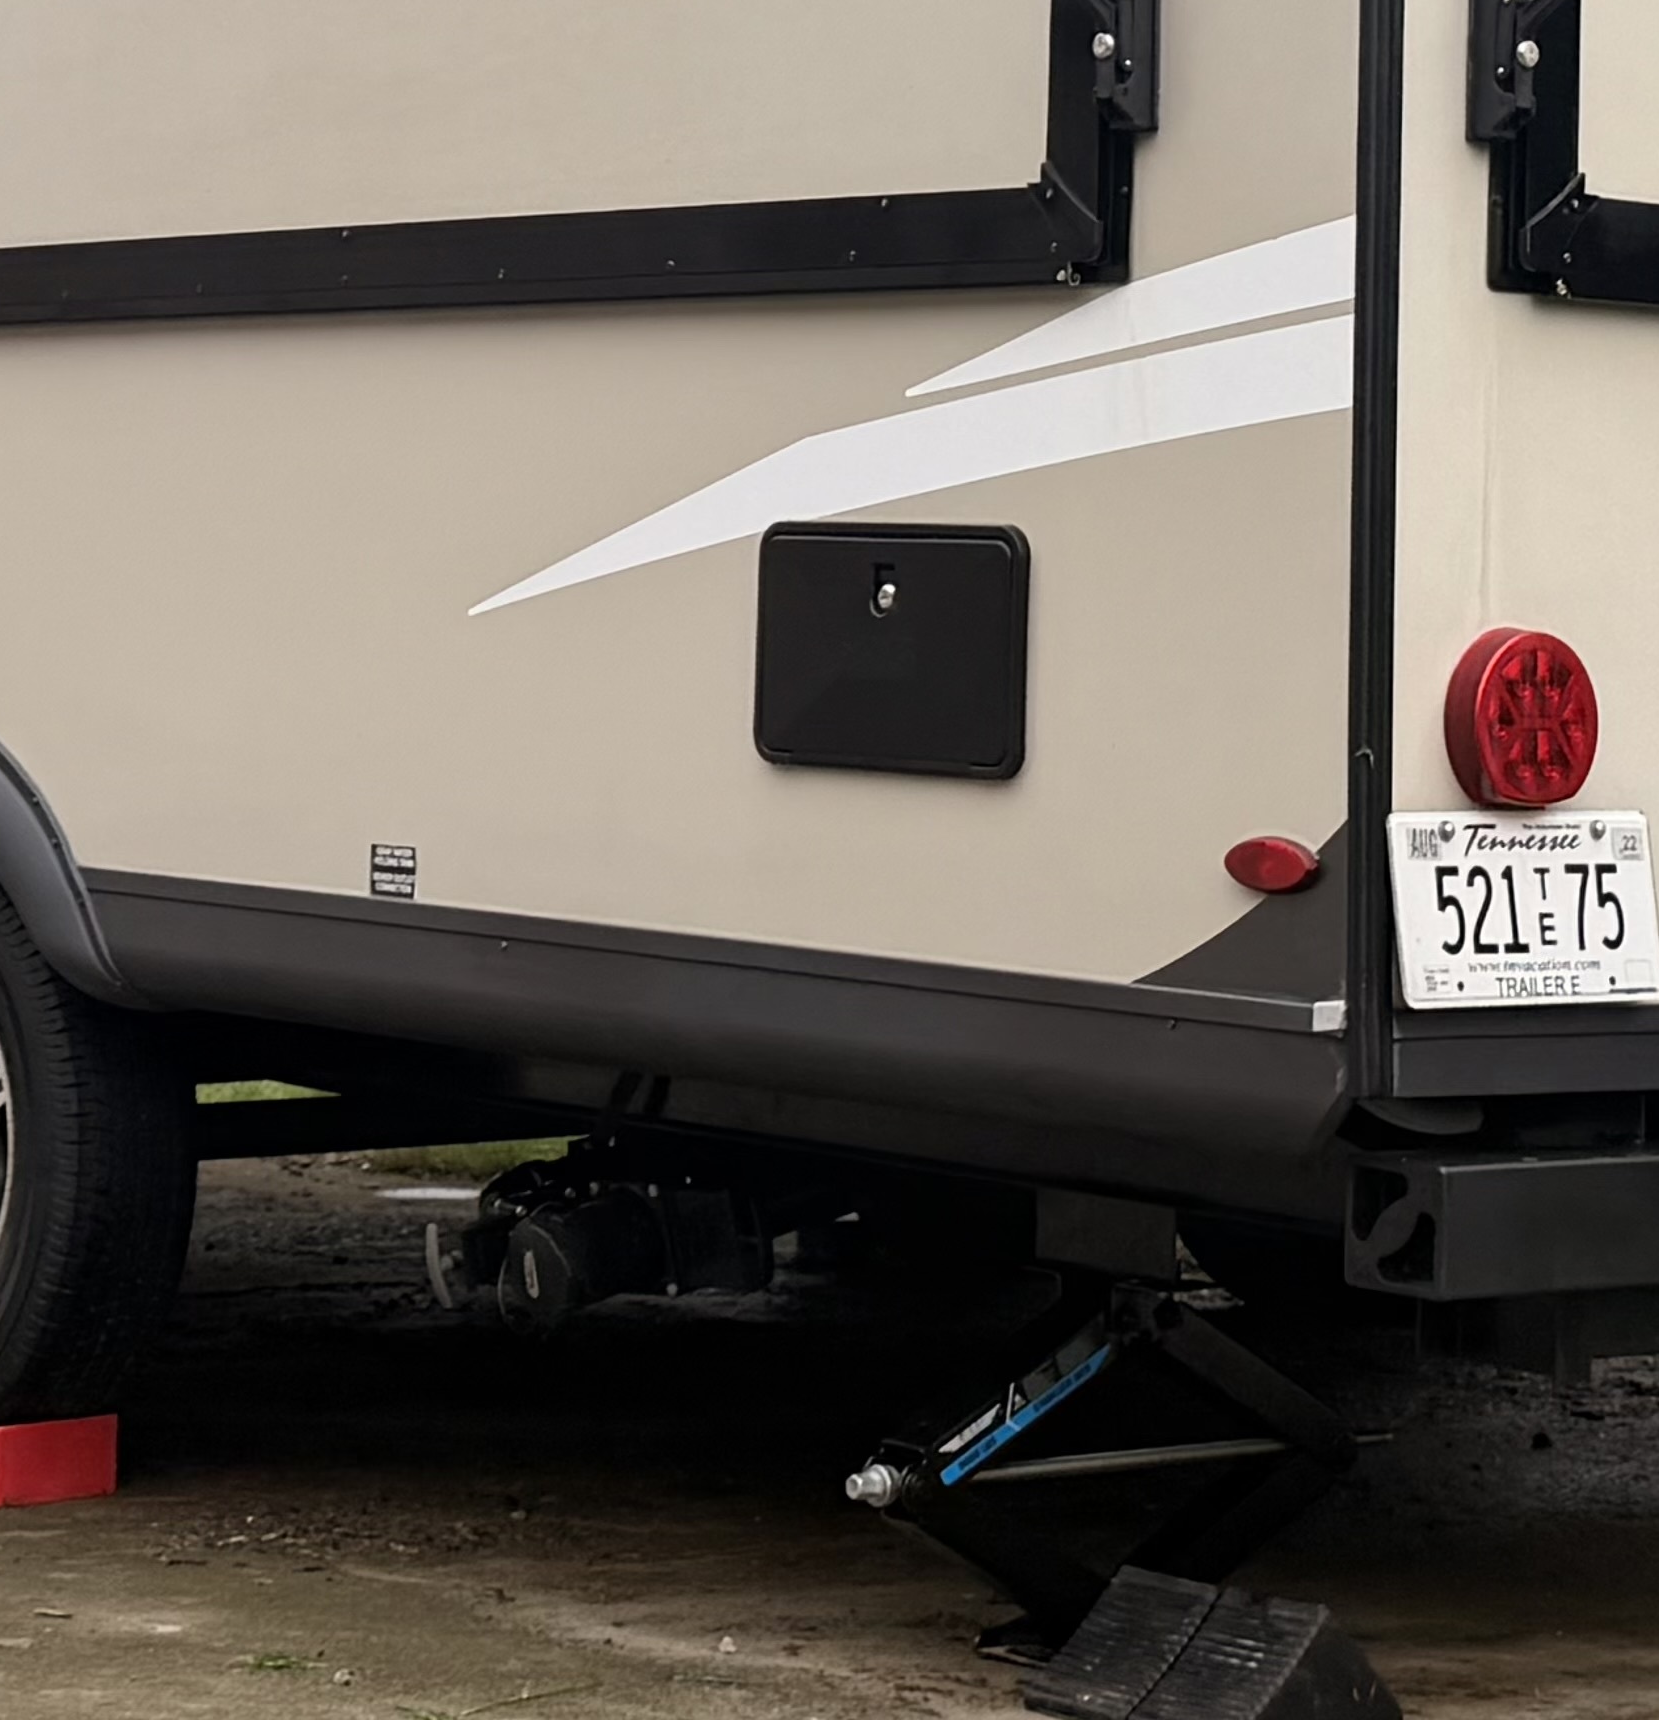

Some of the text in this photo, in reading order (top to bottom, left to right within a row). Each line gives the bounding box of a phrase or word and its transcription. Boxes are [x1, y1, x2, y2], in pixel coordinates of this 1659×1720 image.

[1411, 827, 1439, 858] AUG
[1463, 824, 1581, 857] Tennessee
[1496, 976, 1566, 997] TRAILER
